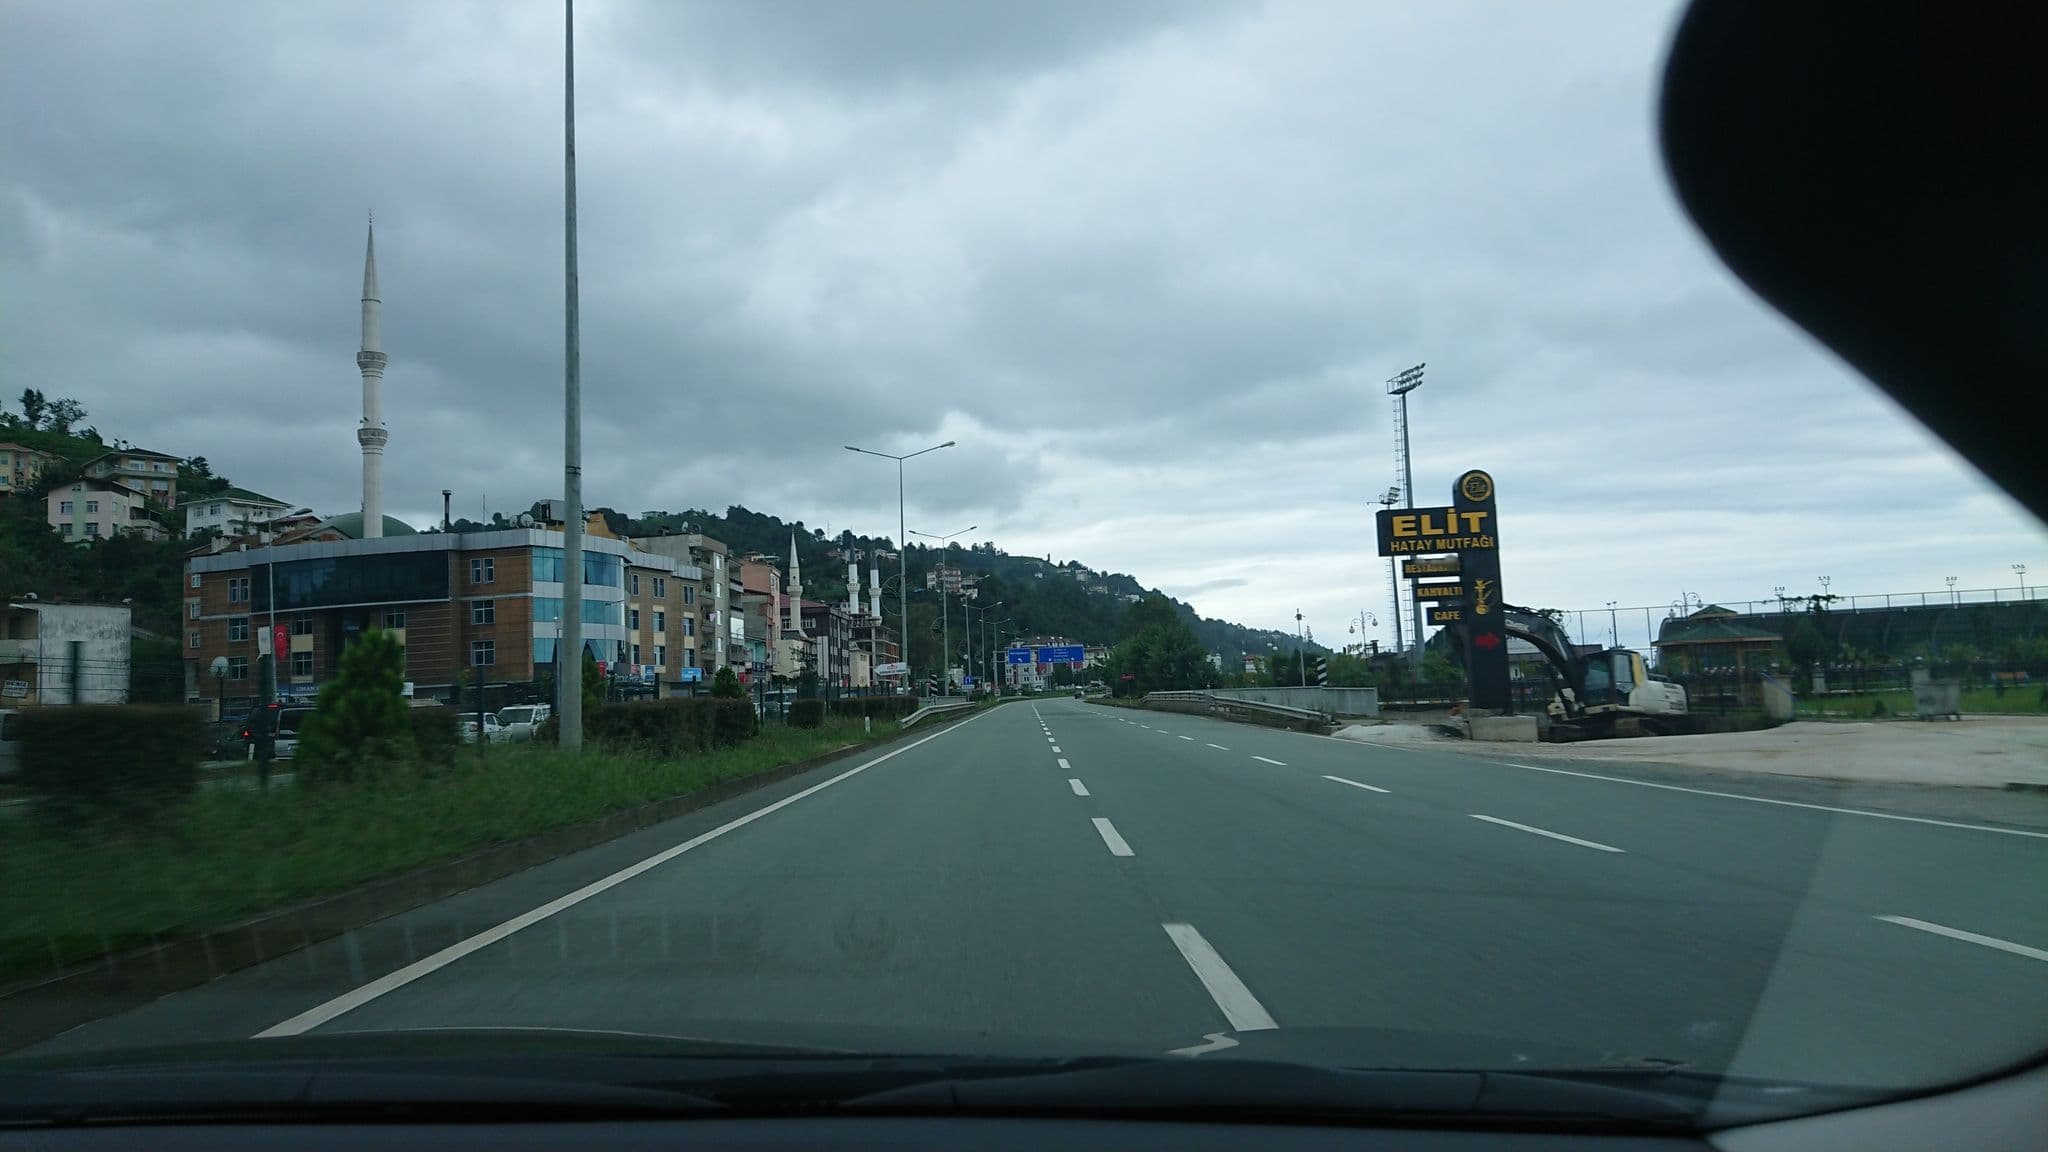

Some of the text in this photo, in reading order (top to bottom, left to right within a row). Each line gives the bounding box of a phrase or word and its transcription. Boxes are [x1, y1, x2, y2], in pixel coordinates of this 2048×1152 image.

[1392, 508, 1488, 537] ELİT
[1391, 535, 1494, 552] HATAY MUTFAĞI
[1434, 610, 1461, 621] CAFE
